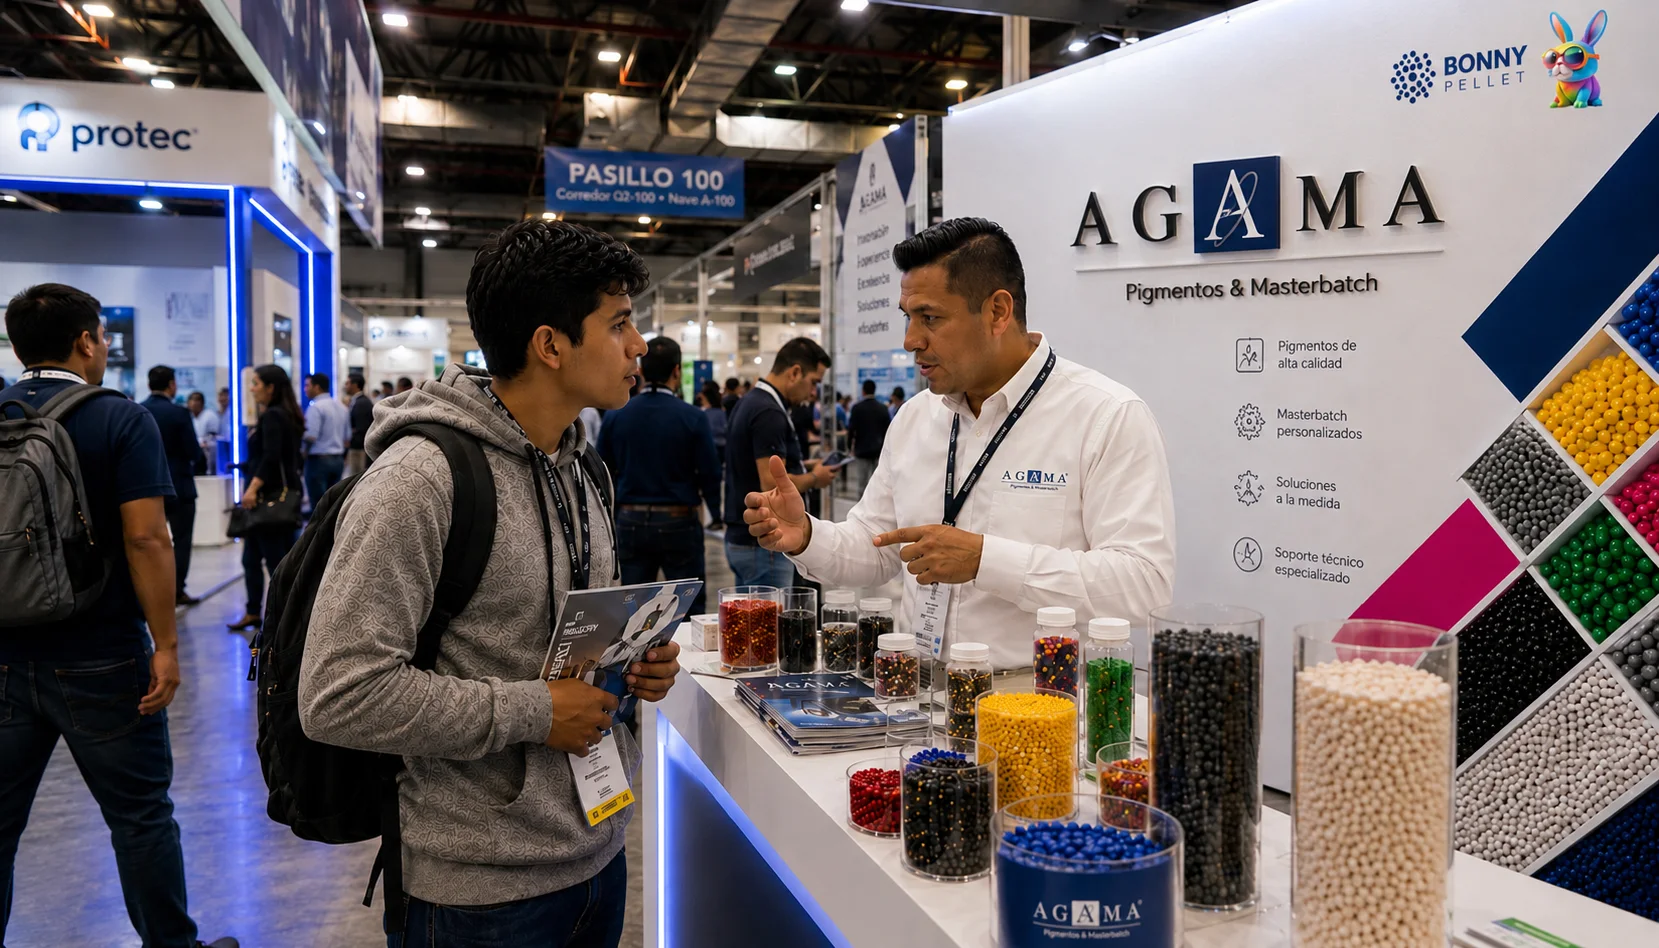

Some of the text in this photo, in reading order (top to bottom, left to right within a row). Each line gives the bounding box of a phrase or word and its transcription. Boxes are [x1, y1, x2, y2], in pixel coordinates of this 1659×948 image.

[1444, 44, 1528, 76] BONNY
[1444, 70, 1525, 92] PELLET
[72, 120, 192, 152] protec
[568, 162, 724, 191] PASILLO 100
[556, 187, 611, 203] Corredor
[668, 192, 699, 206] Nave
[700, 194, 736, 208] A-100
[1069, 162, 1446, 248] AGAMA
[1126, 272, 1378, 305] Pigmentos & Masterbatch
[1277, 339, 1357, 355] Pigmentos de
[1277, 356, 1342, 369] alta calidad
[1277, 408, 1348, 422] Masterbatch
[1277, 426, 1363, 440] personalizados
[1276, 476, 1337, 492] Soluciones
[1276, 493, 1341, 510] a la medida
[1275, 546, 1364, 569] Soporte técnico
[1275, 564, 1350, 584] especializado
[1033, 901, 1141, 924] AGAMA
